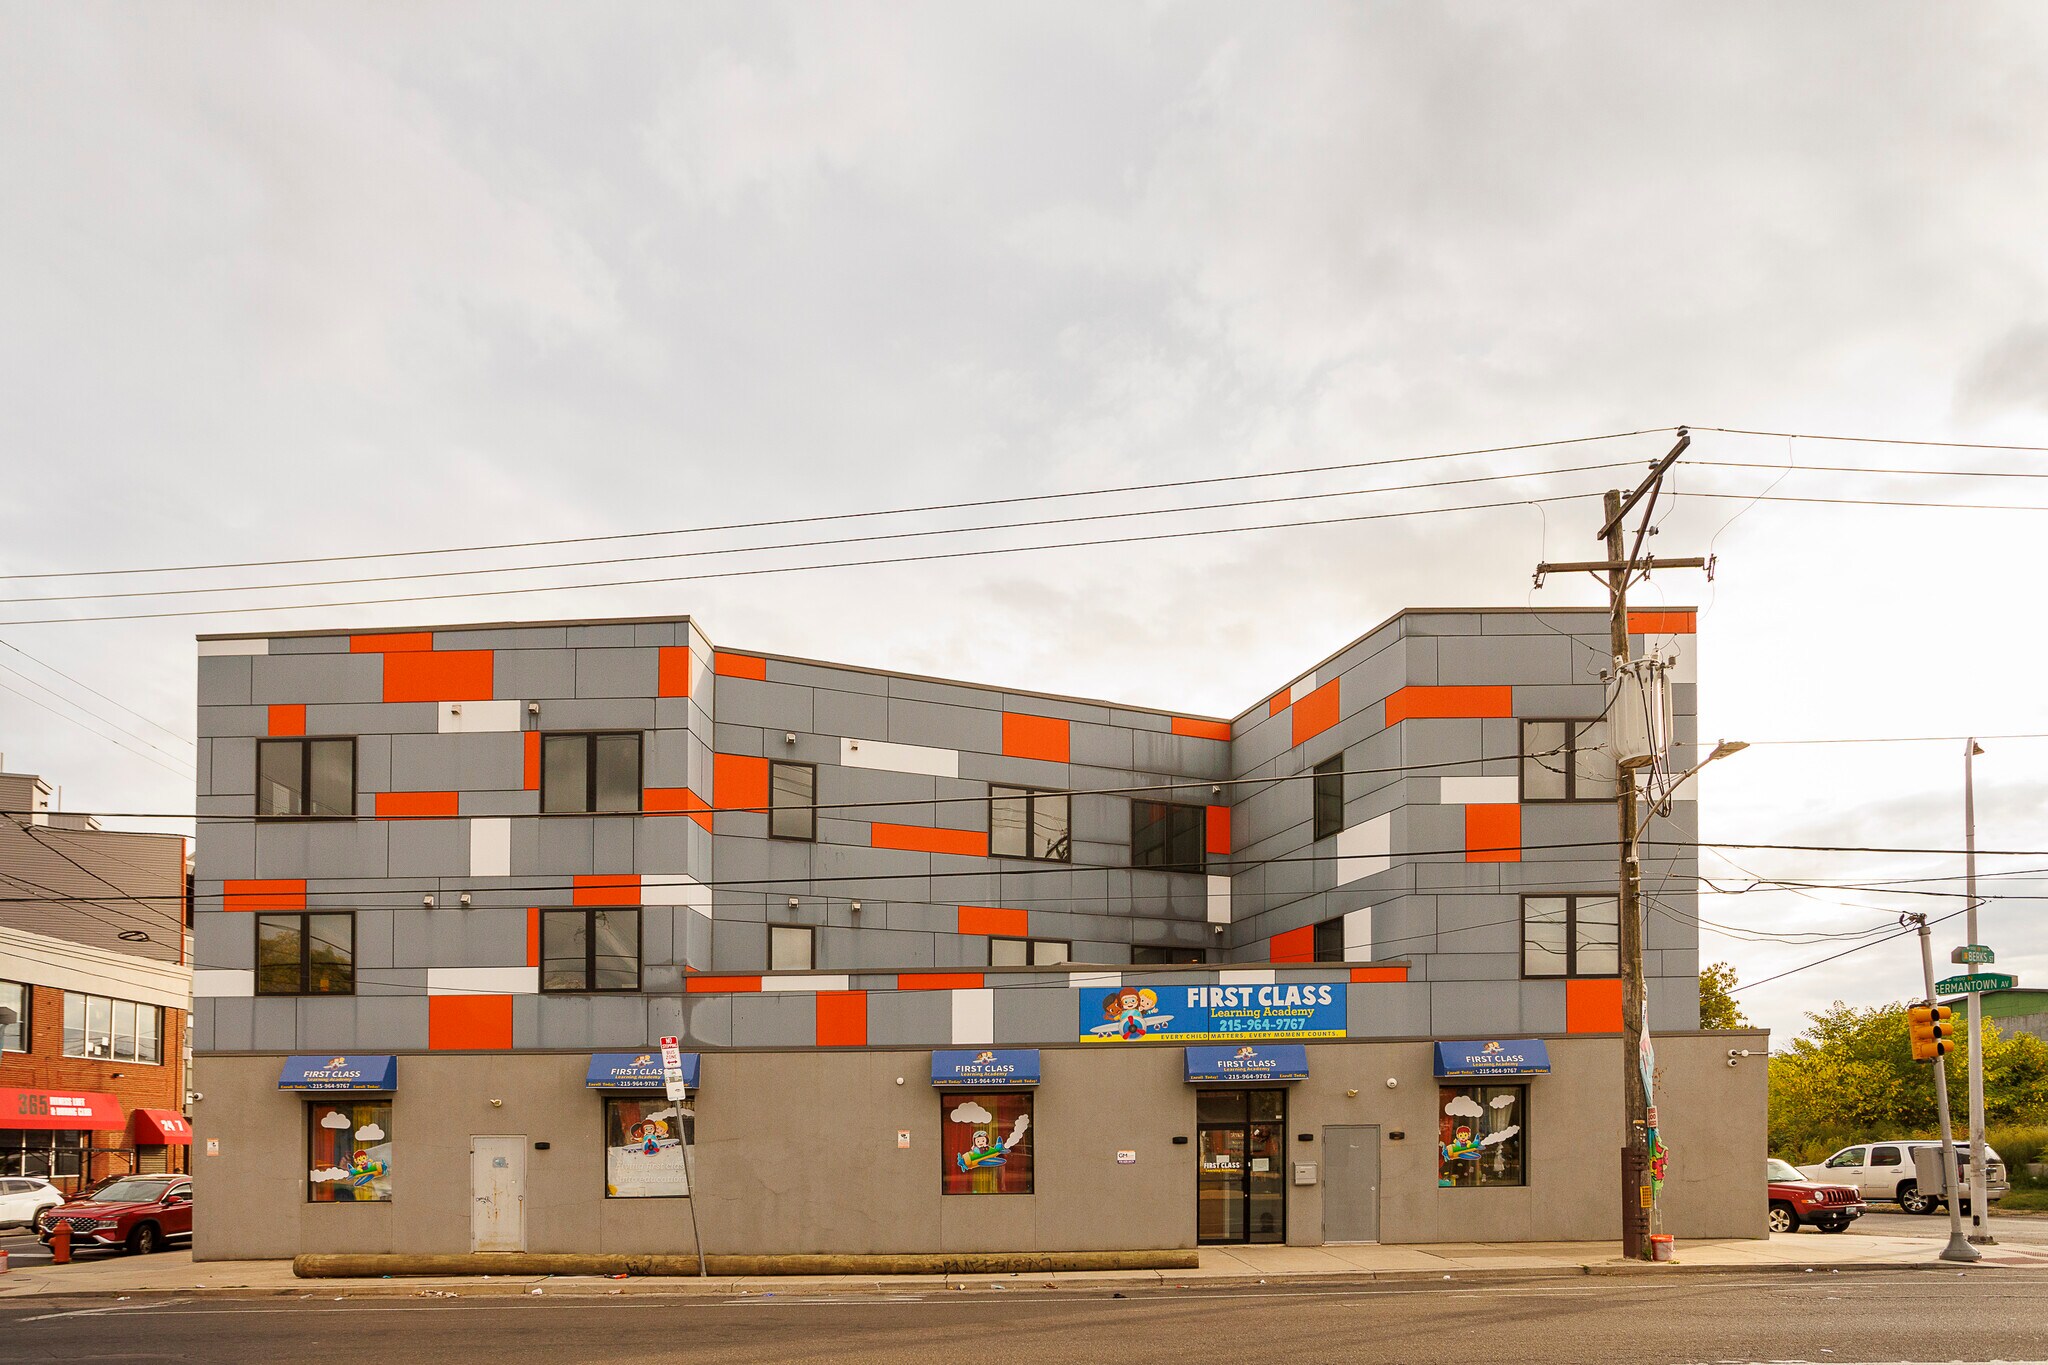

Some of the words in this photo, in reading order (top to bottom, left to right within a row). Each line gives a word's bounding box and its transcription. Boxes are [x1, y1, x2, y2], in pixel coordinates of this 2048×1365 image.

[1968, 952, 1987, 962] BERKS
[1935, 979, 1997, 994] GERMANTOWN
[1187, 987, 1253, 1008] FIRST
[1258, 986, 1332, 1006] CLASS
[1211, 1008, 1260, 1018] Learning
[1263, 1006, 1314, 1017] Academy
[1219, 1018, 1305, 1031] 215-964-9767
[18, 1094, 48, 1115] 365
[646, 1161, 664, 1170] first
[666, 1161, 684, 1170] clas
